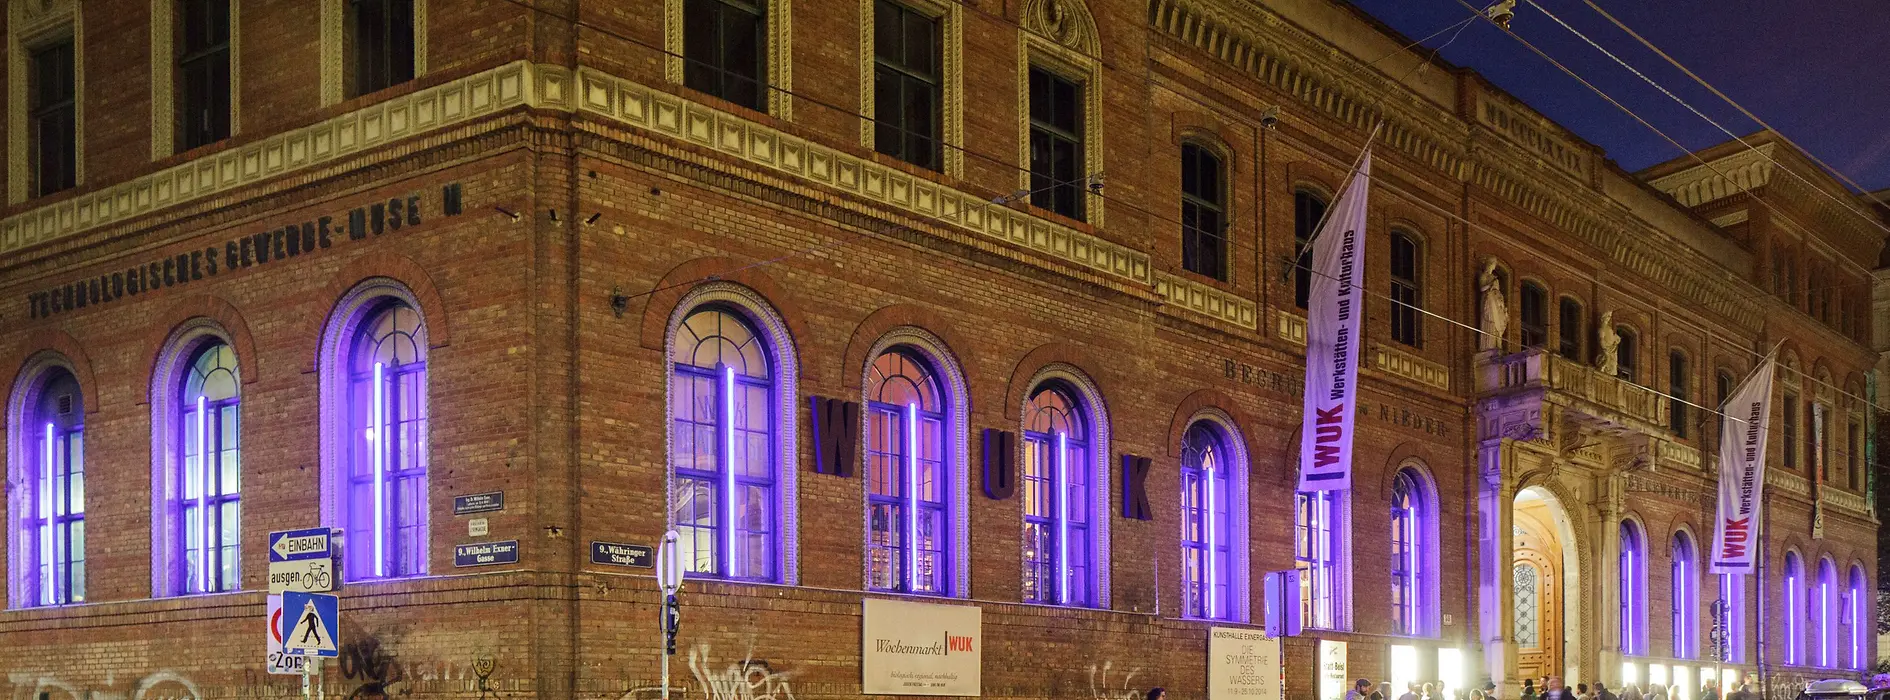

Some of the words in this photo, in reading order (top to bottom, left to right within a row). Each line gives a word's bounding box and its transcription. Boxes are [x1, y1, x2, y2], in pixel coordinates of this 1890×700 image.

[1338, 230, 1355, 297] Kulturhaus
[28, 246, 218, 320] TECHNOLOGISCHES
[1338, 299, 1350, 321] und
[1746, 402, 1761, 446] Kulturhaus
[1314, 403, 1344, 468] WUK
[1746, 447, 1756, 461] und
[288, 537, 324, 552] EINBAHN
[1722, 516, 1749, 559] WUK
[477, 554, 495, 562] Gasse
[611, 555, 635, 565] Straße
[1213, 631, 1243, 640] KUNSTHALLE
[876, 639, 942, 656] Wochenmarkt
[949, 635, 973, 652] WUK
[1242, 645, 1253, 655] DIE
[276, 651, 311, 669] Zon
[1226, 655, 1268, 665] SYMMETRIE
[1240, 665, 1255, 675] DES
[1229, 675, 1265, 685] WASSERS
